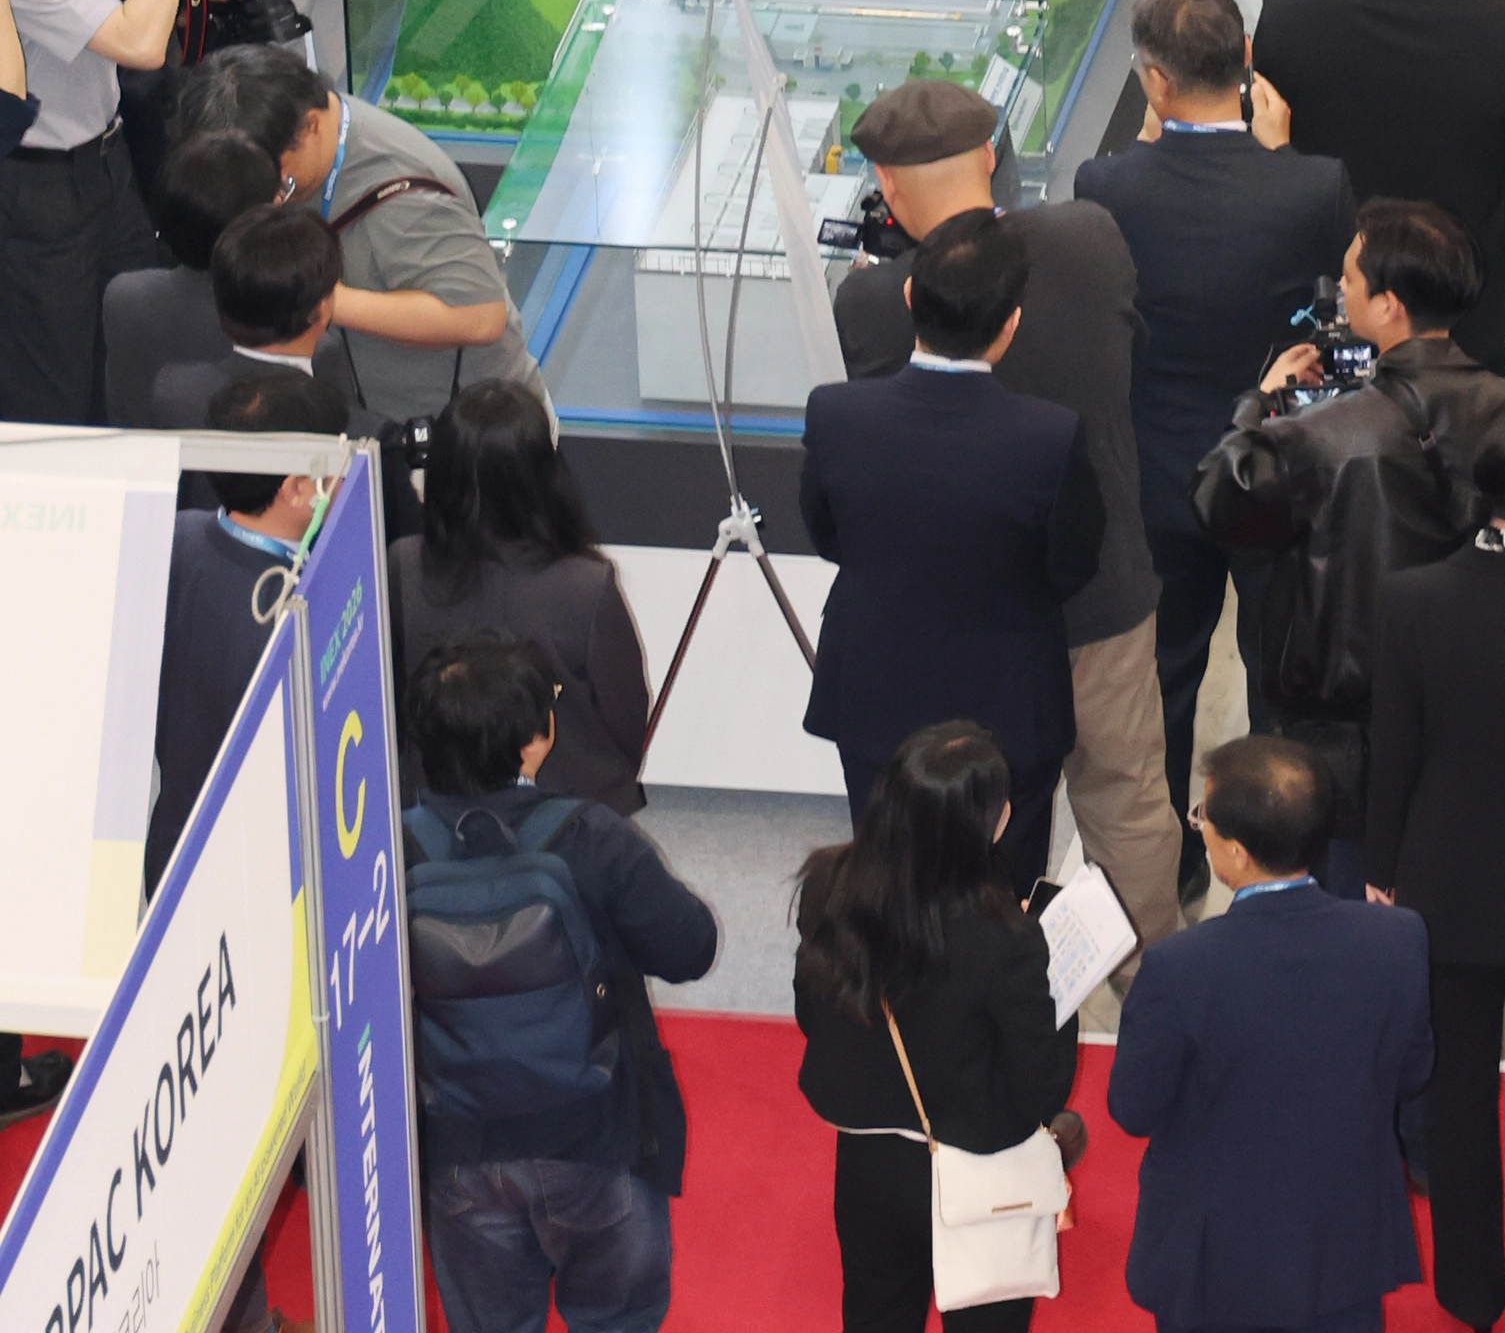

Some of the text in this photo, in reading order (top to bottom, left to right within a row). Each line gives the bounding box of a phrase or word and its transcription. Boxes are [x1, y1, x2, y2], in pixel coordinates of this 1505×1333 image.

[319, 623, 342, 685] INEX
[340, 576, 363, 639] 2026
[334, 709, 366, 860] C
[330, 850, 390, 1032] 17-2
[132, 929, 237, 1223] KOREA
